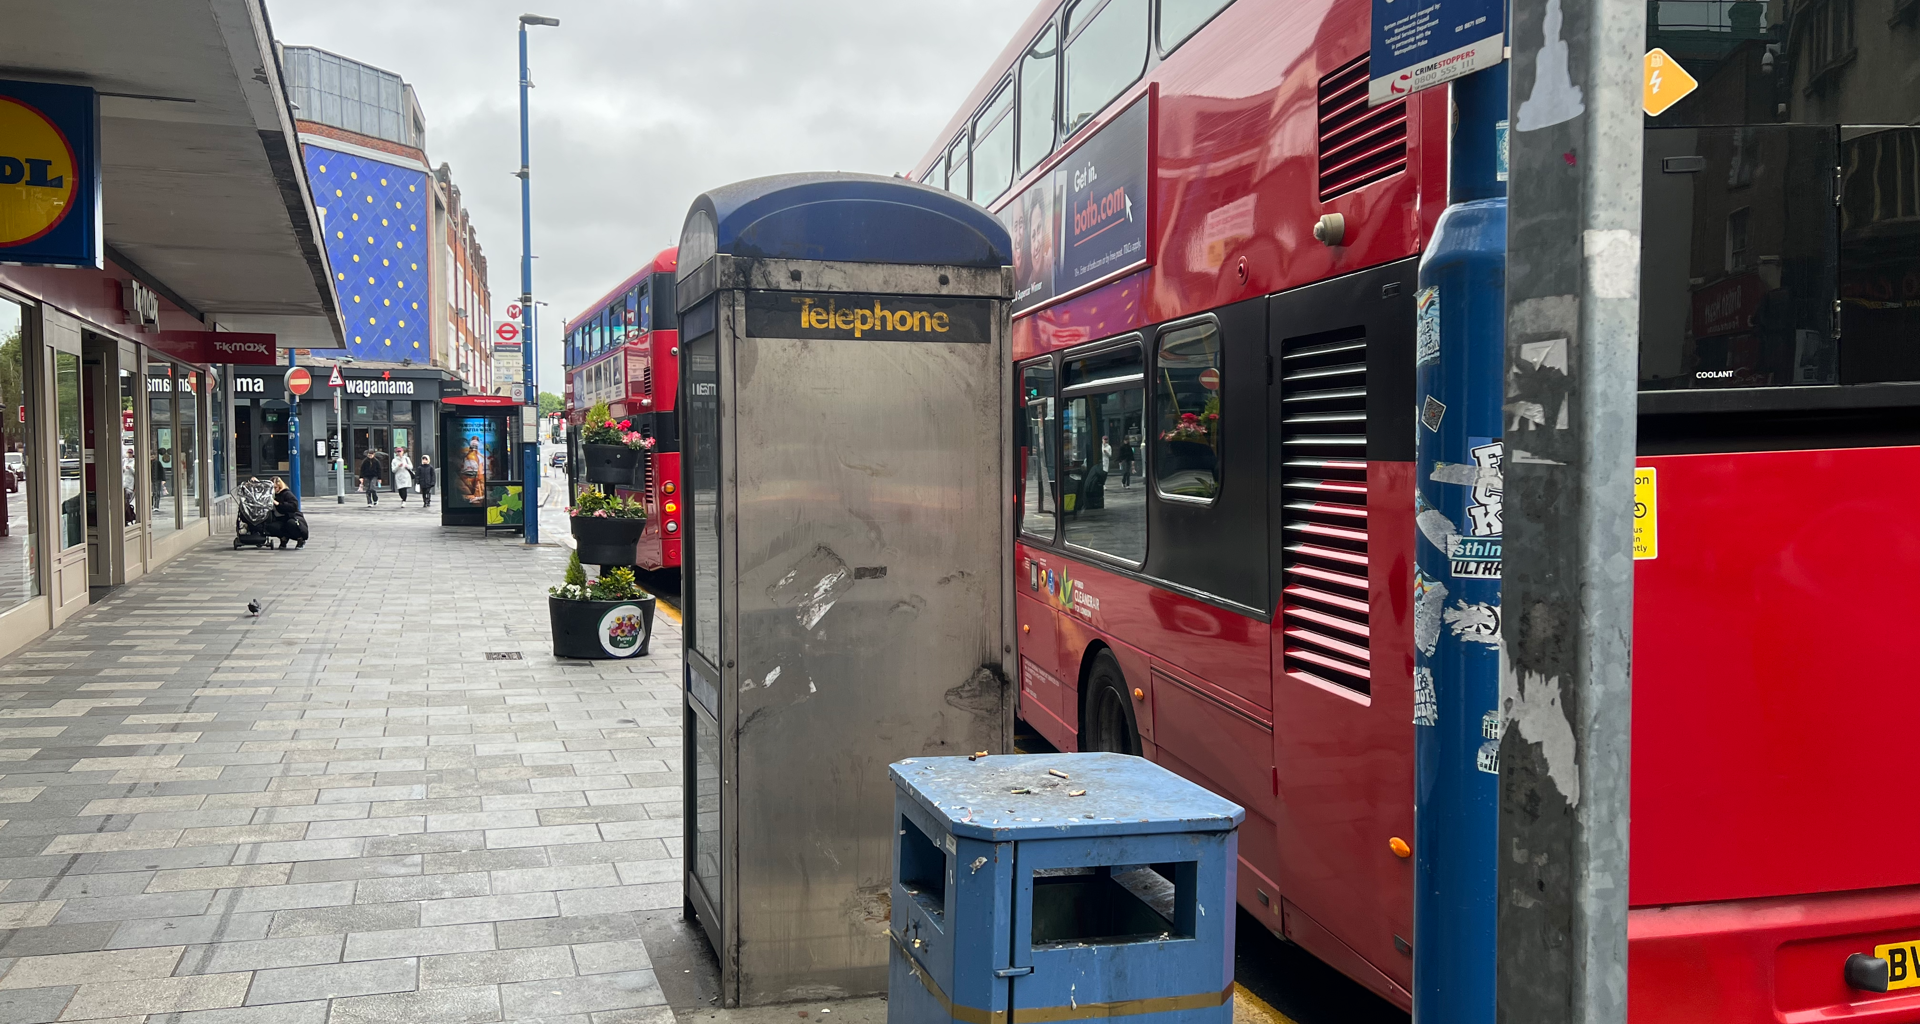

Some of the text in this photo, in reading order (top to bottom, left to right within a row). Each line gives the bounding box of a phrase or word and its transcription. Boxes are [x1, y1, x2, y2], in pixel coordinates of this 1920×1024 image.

[1415, 49, 1475, 76] CRIMESTOPPERS
[1415, 71, 1437, 85] 0800
[1440, 64, 1456, 76] 555
[1074, 161, 1097, 193] Get in.
[1074, 186, 1124, 235] botb.com
[791, 297, 949, 337] Telephone
[234, 377, 264, 392] ma
[1696, 370, 1734, 379] COOLANT
[345, 379, 414, 397] wagamama
[1635, 477, 1649, 485] on
